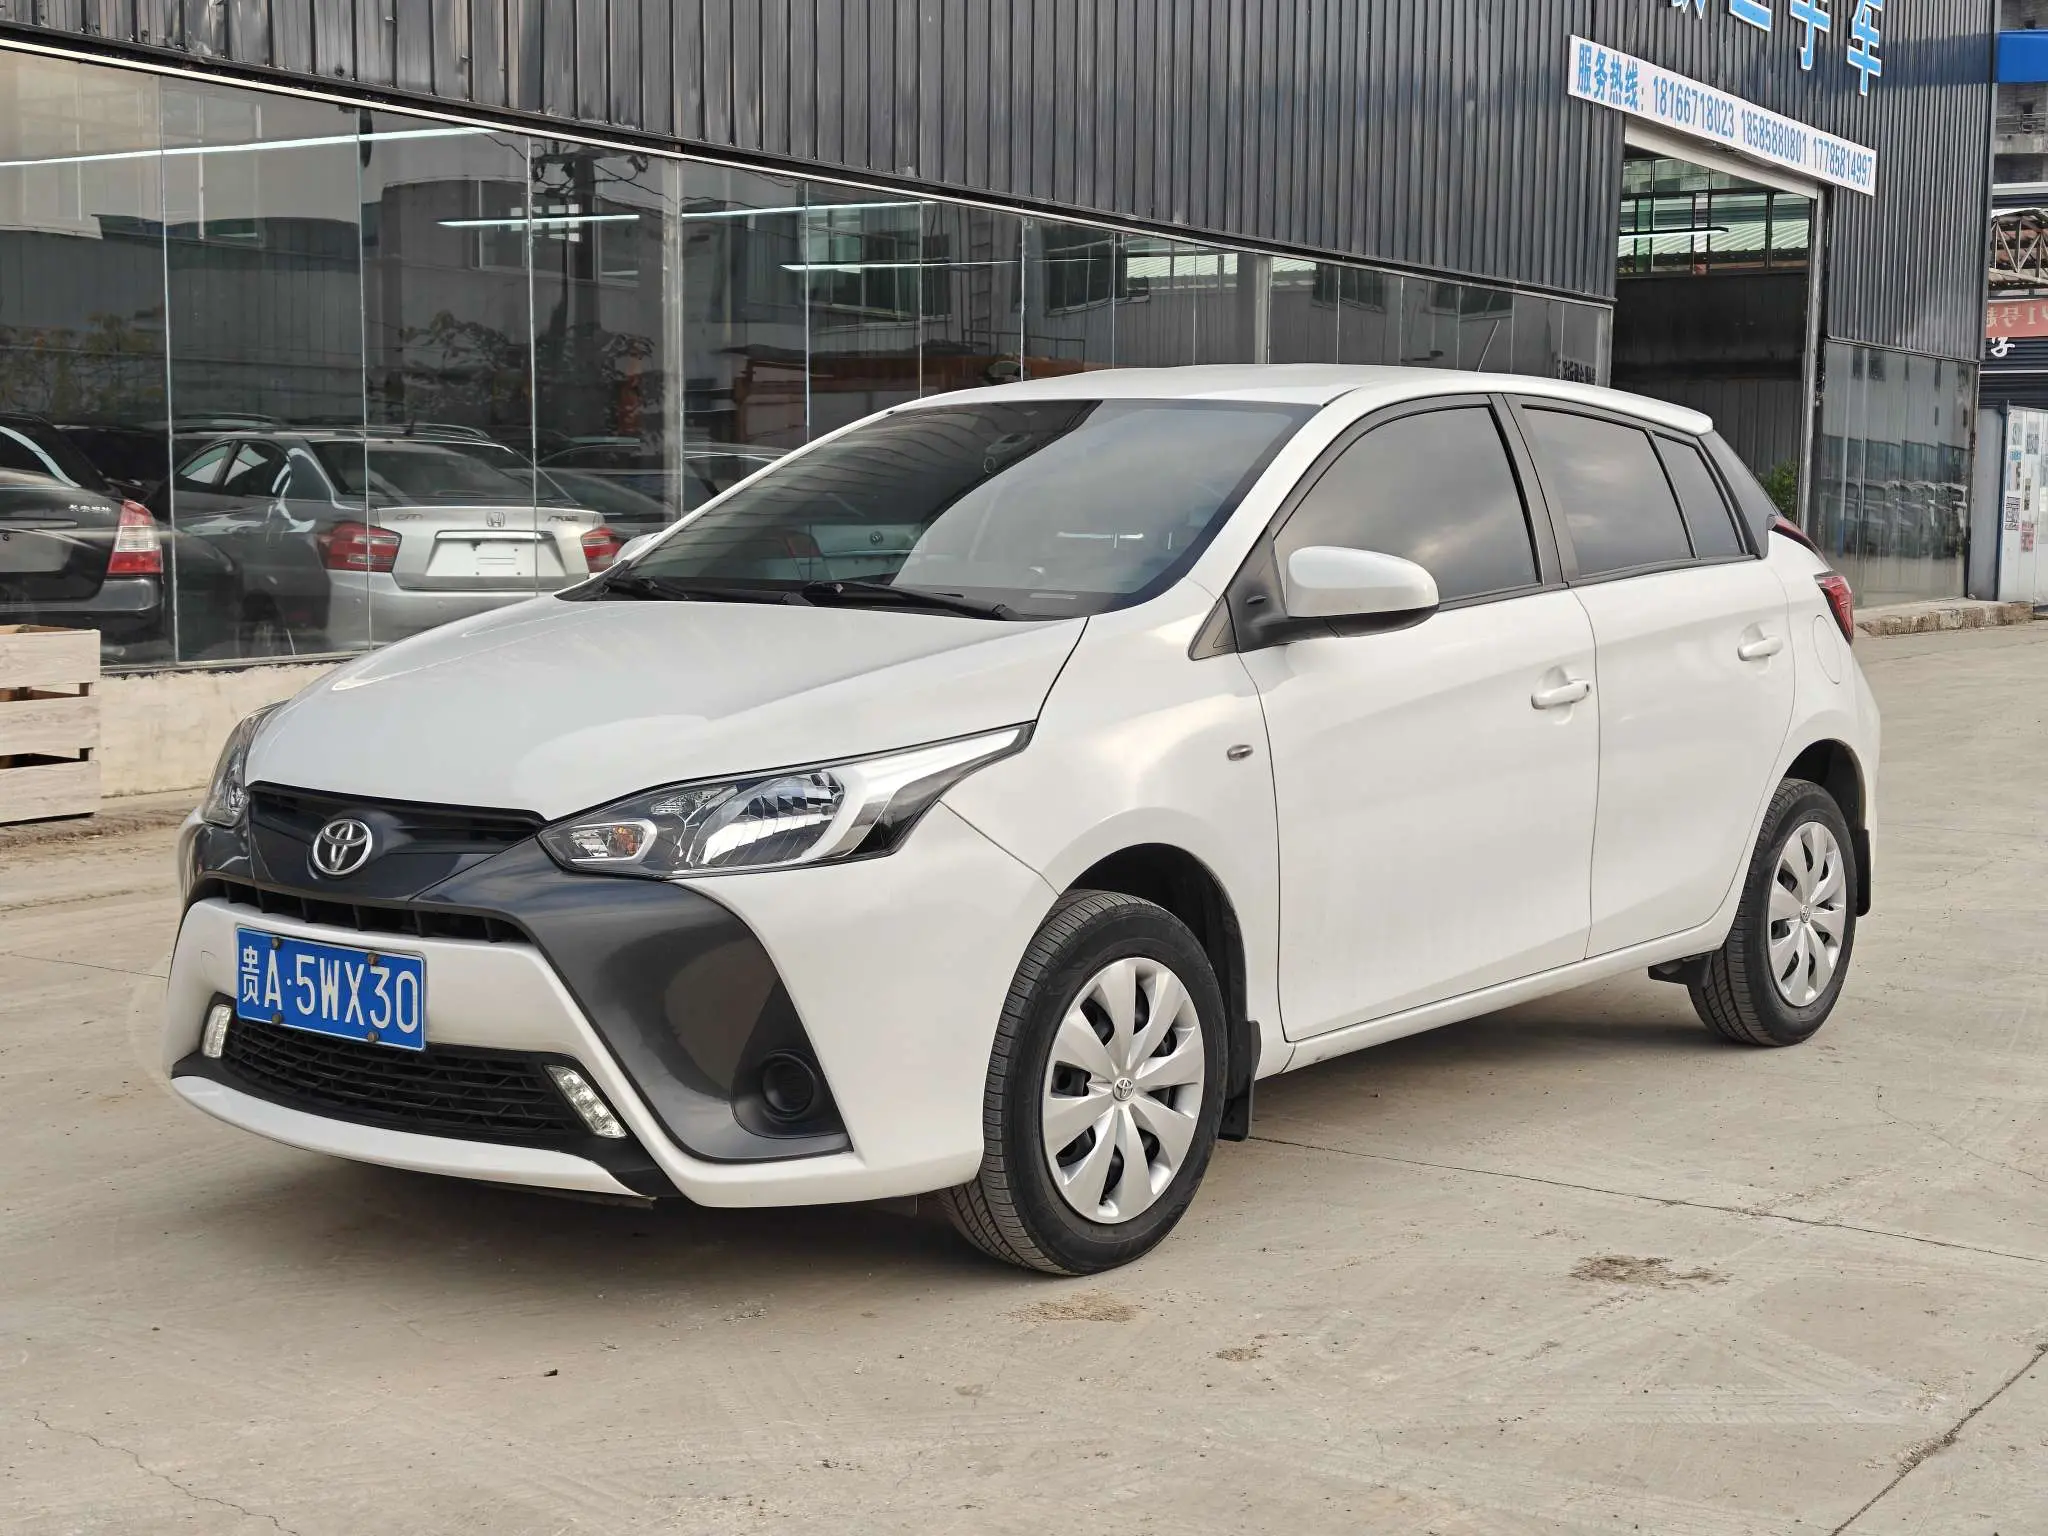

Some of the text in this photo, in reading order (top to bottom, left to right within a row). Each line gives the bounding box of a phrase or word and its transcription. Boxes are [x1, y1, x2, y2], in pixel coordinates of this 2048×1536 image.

[1670, 0, 1882, 96] 手车
[1653, 76, 1735, 138] 18166718023
[241, 946, 418, 1033] 贵A·5WX30
